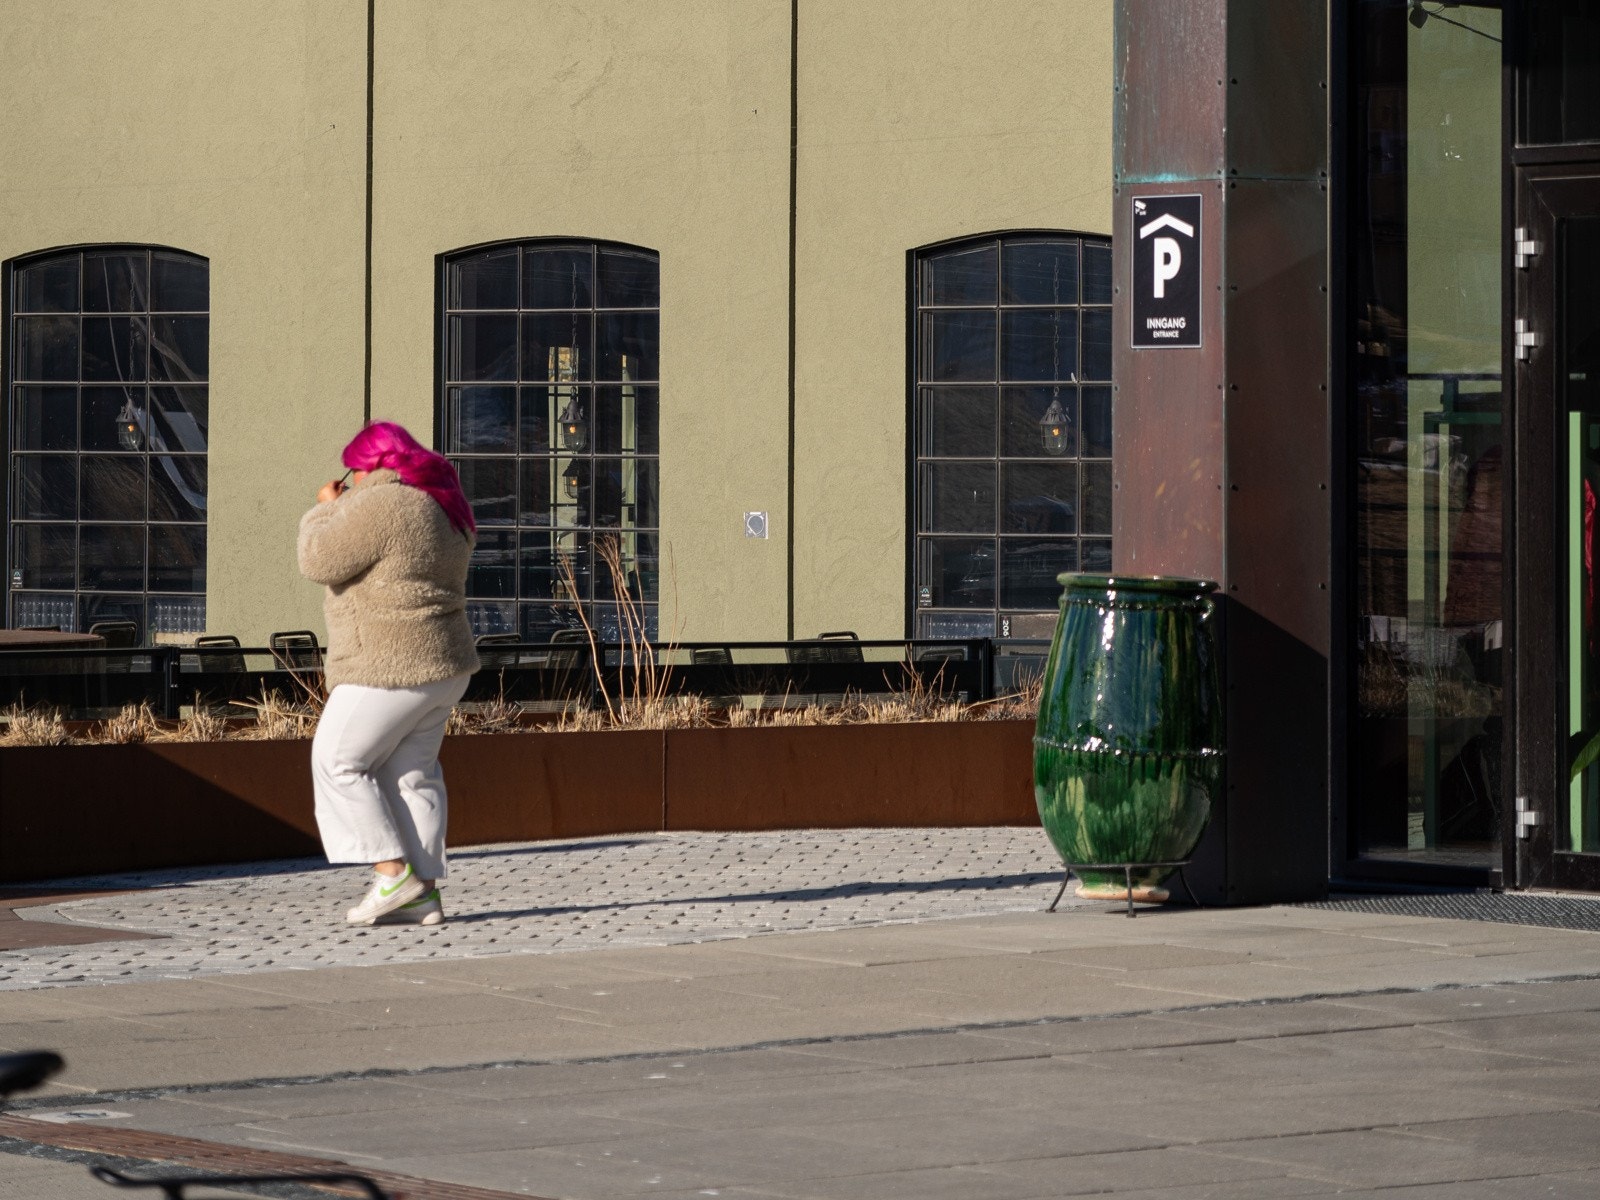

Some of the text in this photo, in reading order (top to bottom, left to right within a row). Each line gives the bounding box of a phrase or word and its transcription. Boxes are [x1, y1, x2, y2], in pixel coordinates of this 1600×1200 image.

[1154, 237, 1182, 298] P
[1146, 317, 1187, 329] INNGANG
[1153, 330, 1180, 338] ENTRANCE
